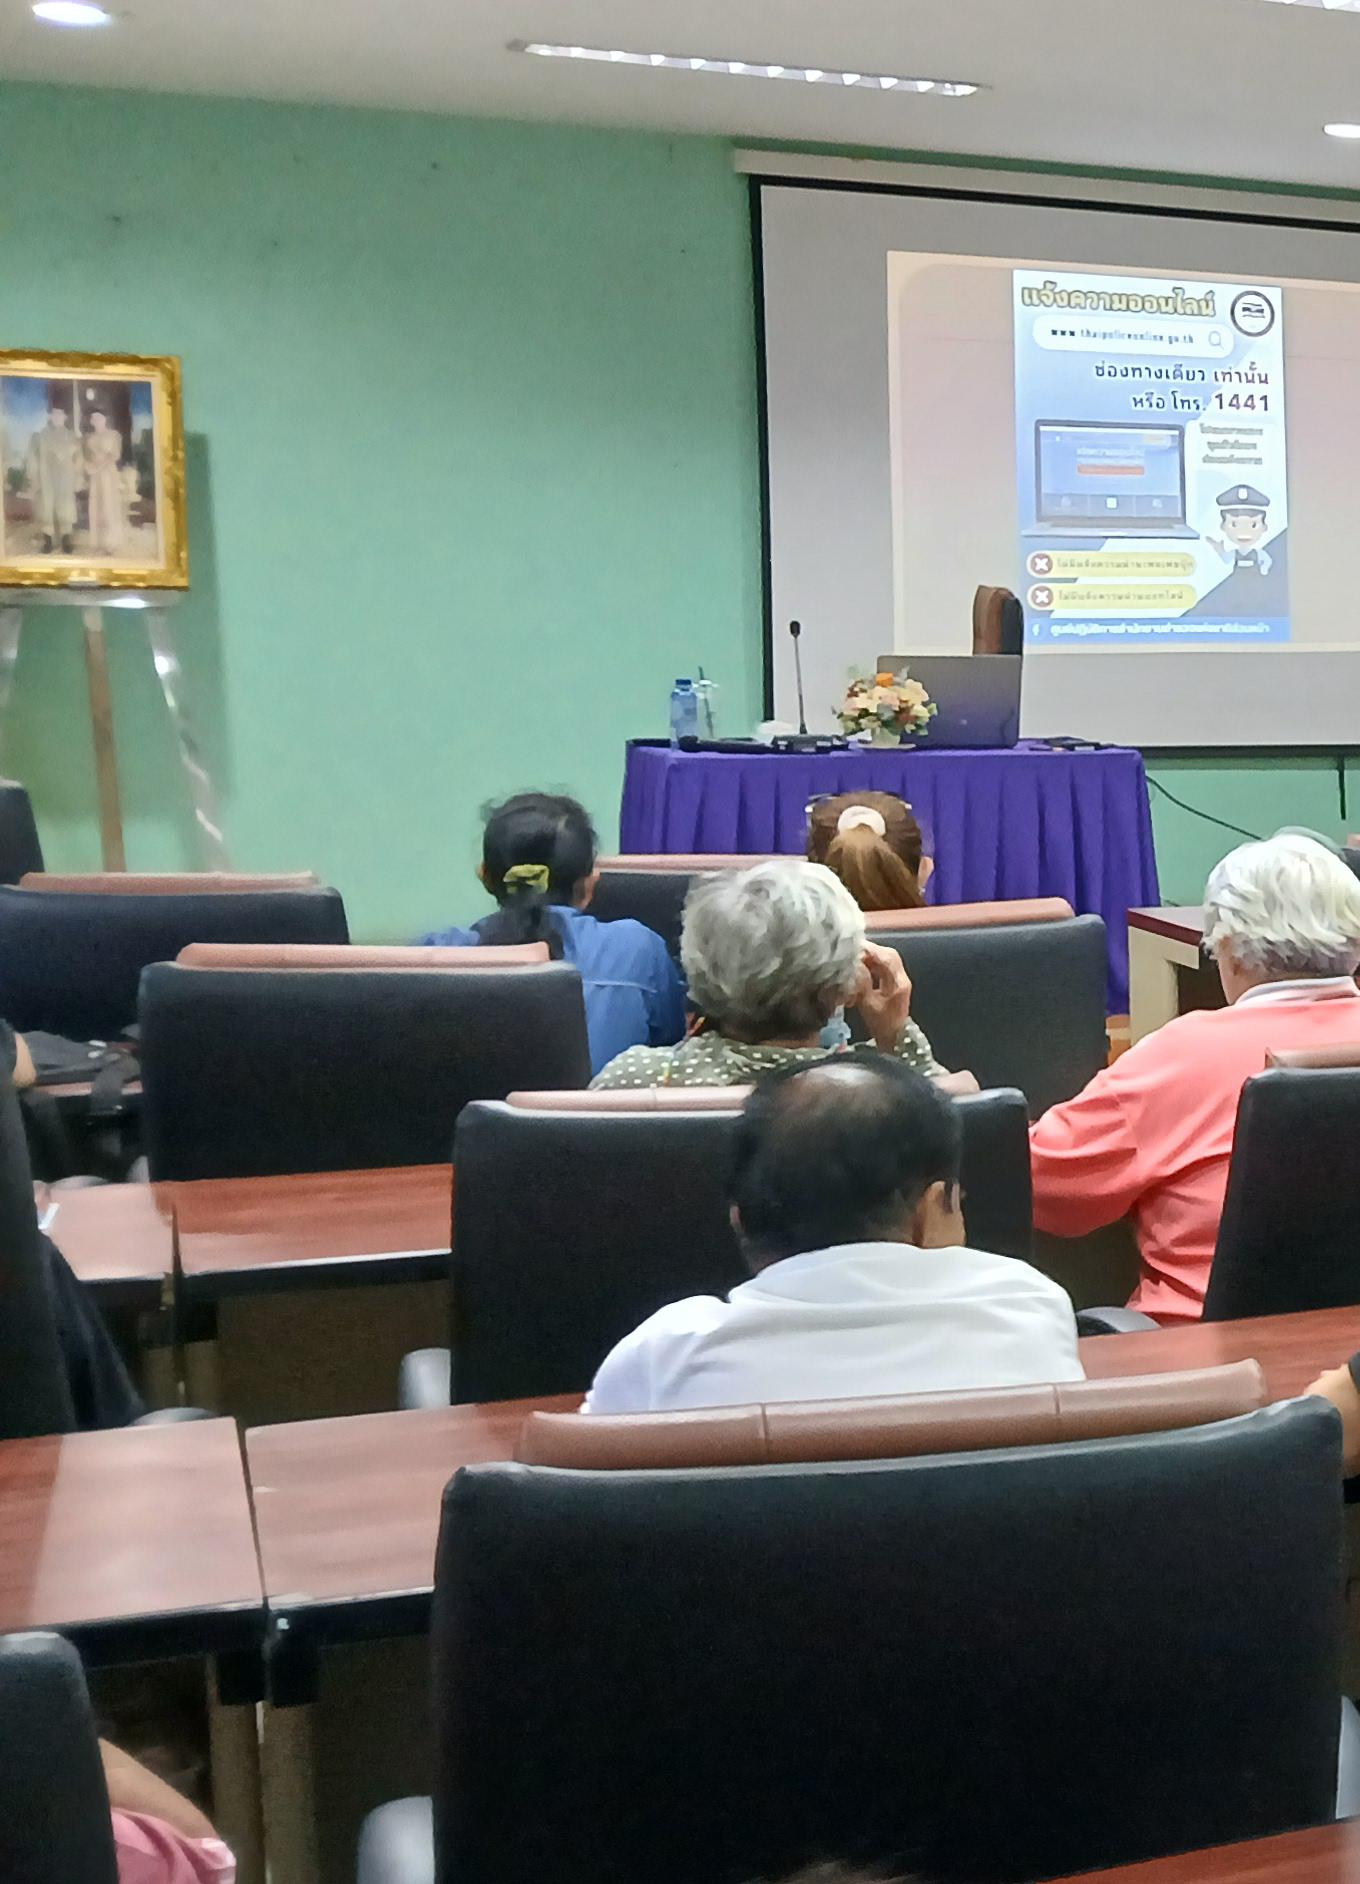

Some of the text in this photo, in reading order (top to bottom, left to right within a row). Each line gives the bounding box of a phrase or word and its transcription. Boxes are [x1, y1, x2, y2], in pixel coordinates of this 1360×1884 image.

[1021, 280, 1216, 317] แจ้งความออนไลน์
[1214, 361, 1269, 385] เท่านั้น
[1132, 391, 1165, 409] หรือ
[1214, 392, 1269, 412] 1441
